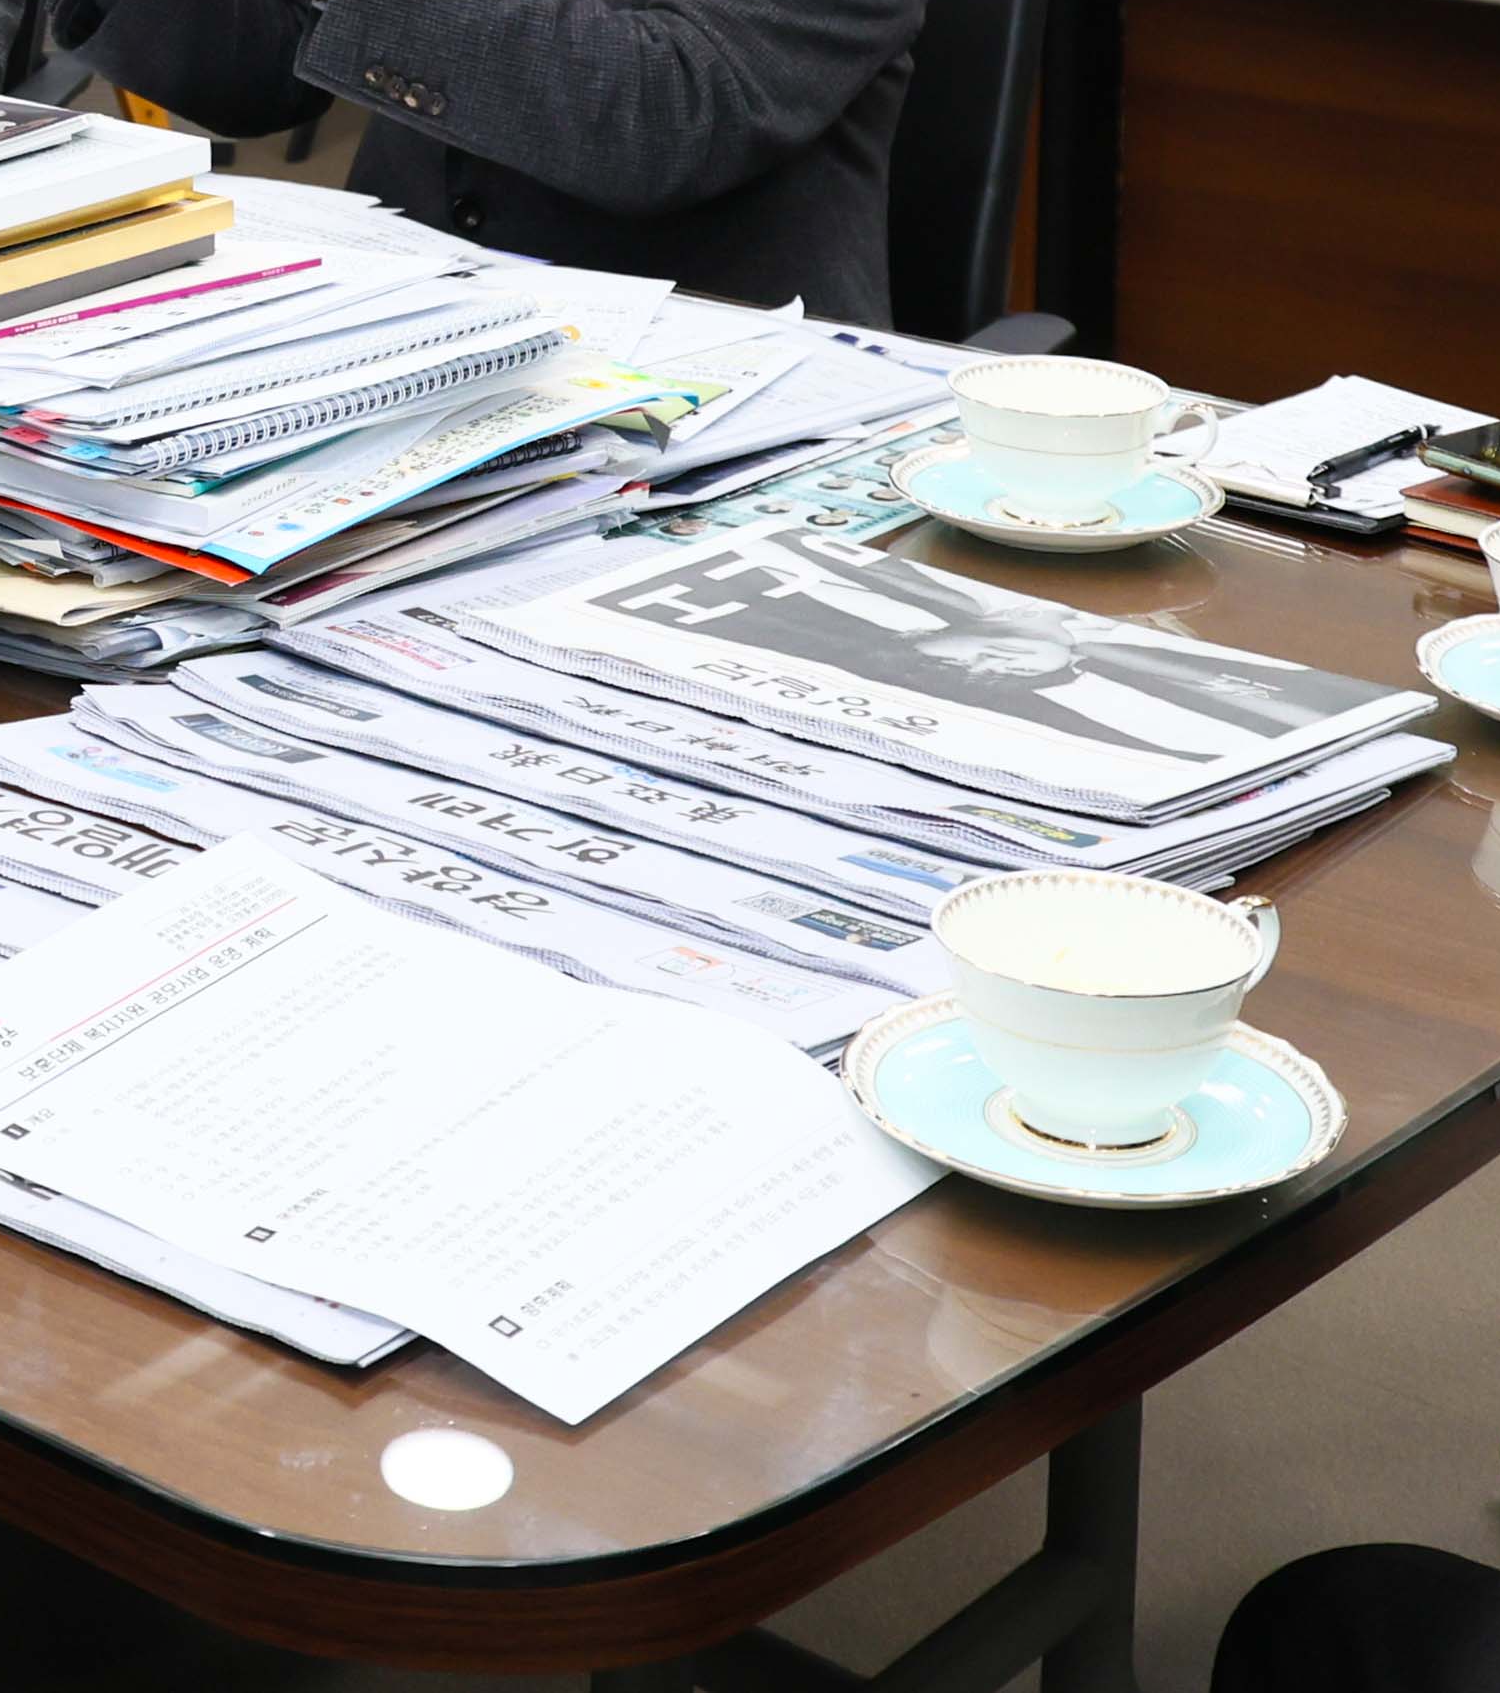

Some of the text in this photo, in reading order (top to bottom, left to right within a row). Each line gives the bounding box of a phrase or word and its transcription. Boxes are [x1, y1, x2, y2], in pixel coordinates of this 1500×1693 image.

[692, 657, 943, 739] 중앙일보
[272, 817, 556, 920] 경향신문
[407, 791, 637, 865] 한겨레
[17, 1039, 81, 1082] 보훈단체
[83, 1002, 149, 1050] 복지지원
[149, 966, 209, 1012] 공모사업
[208, 947, 245, 977] 운영
[244, 924, 278, 955] 계획
